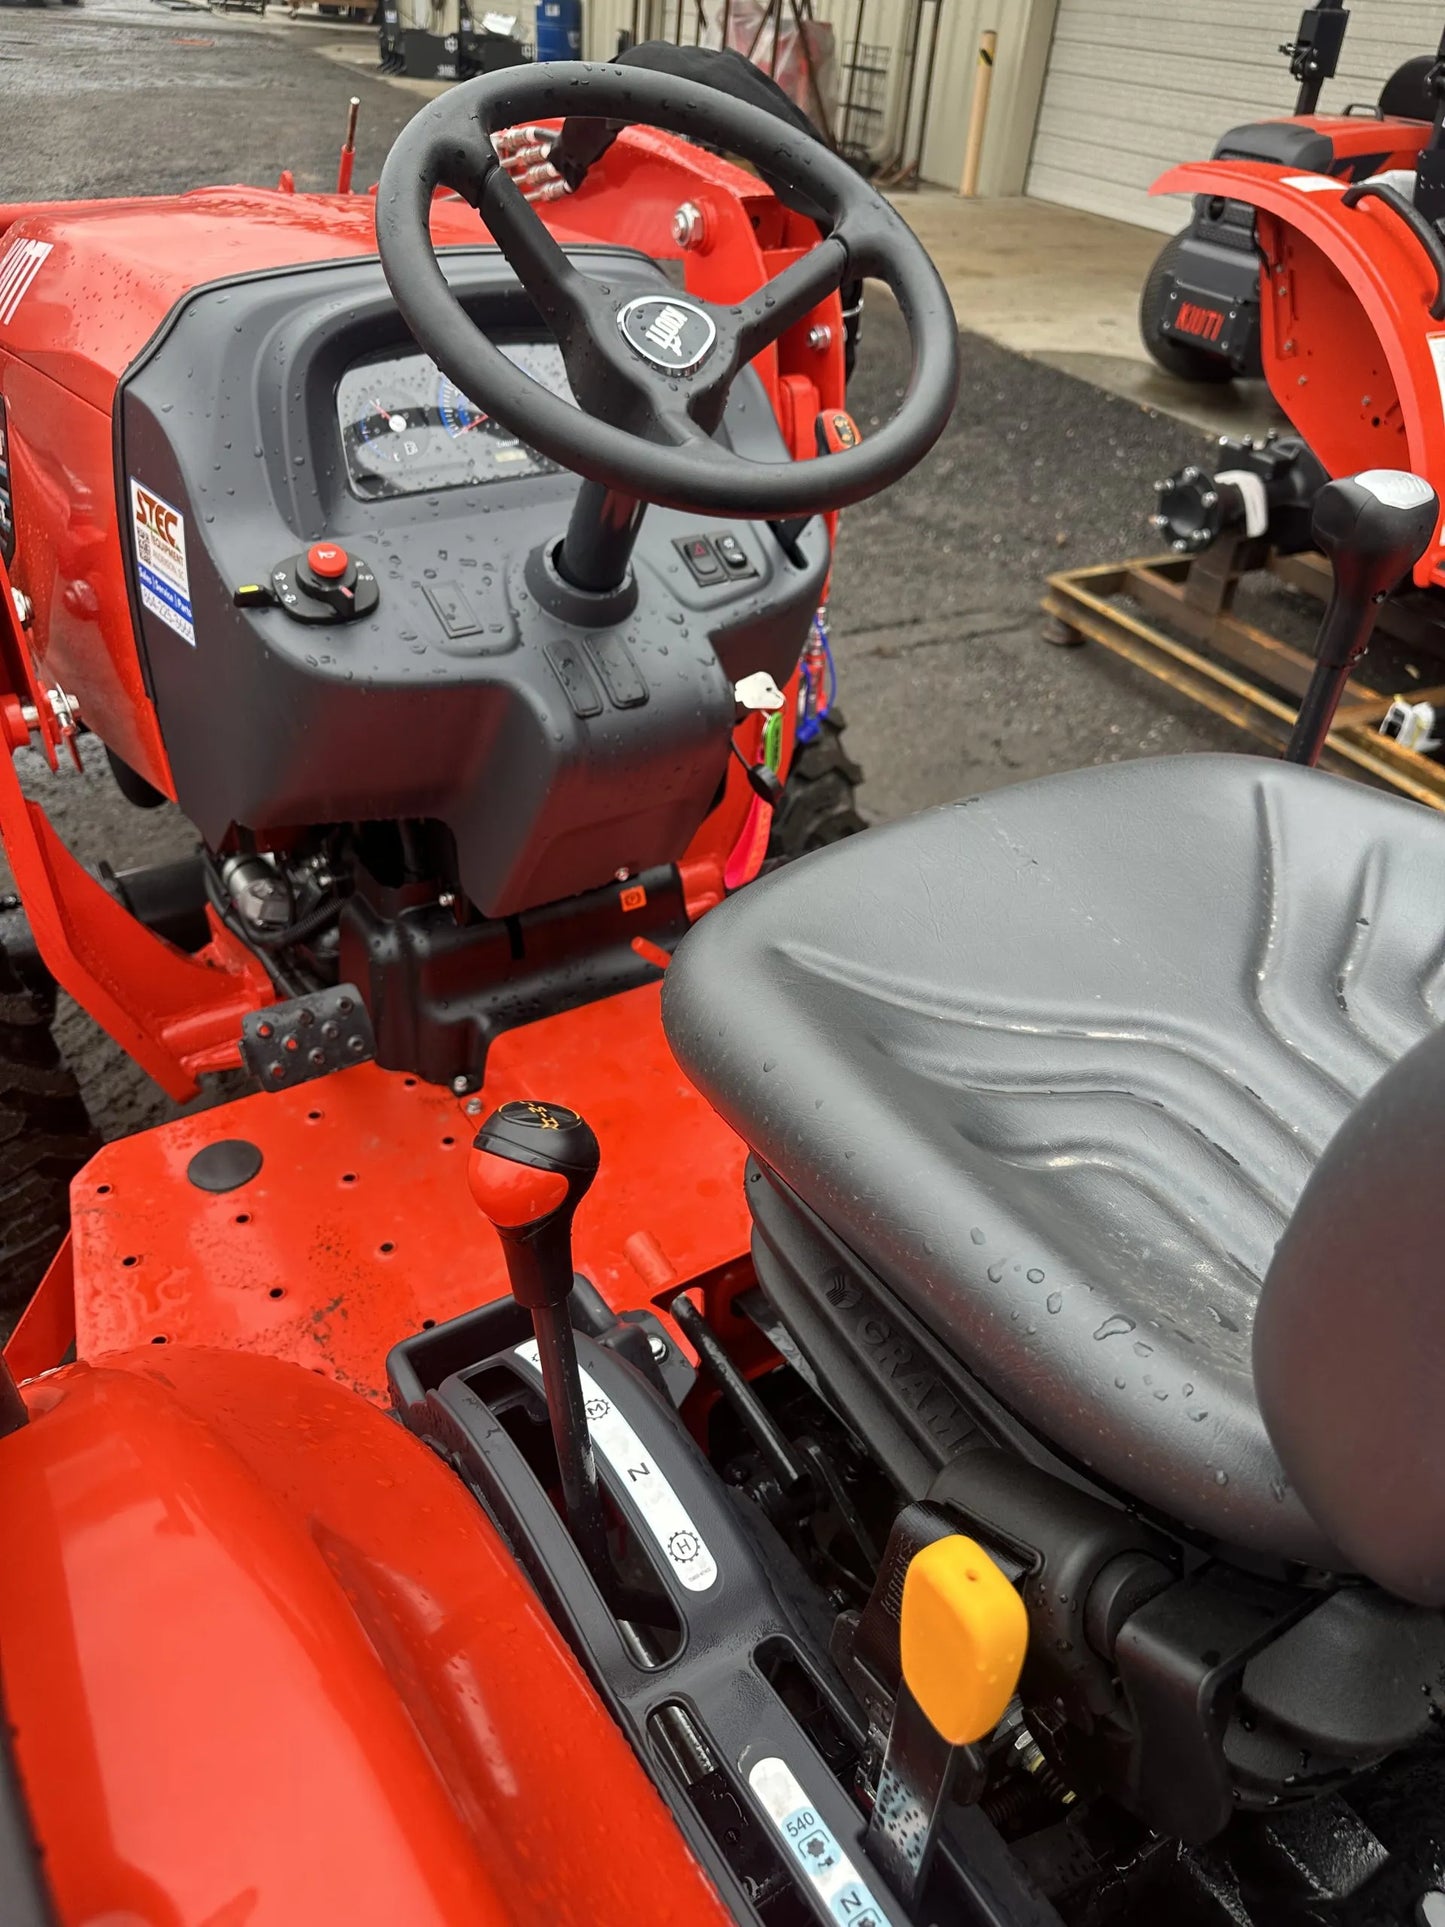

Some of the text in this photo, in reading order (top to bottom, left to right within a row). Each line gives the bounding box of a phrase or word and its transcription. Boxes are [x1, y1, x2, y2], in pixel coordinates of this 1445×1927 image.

[136, 488, 178, 547] STEC
[587, 1403, 604, 1416] M
[627, 1462, 650, 1482] N
[676, 1539, 692, 1555] H
[786, 1811, 815, 1838] 540
[841, 1891, 863, 1914] N
